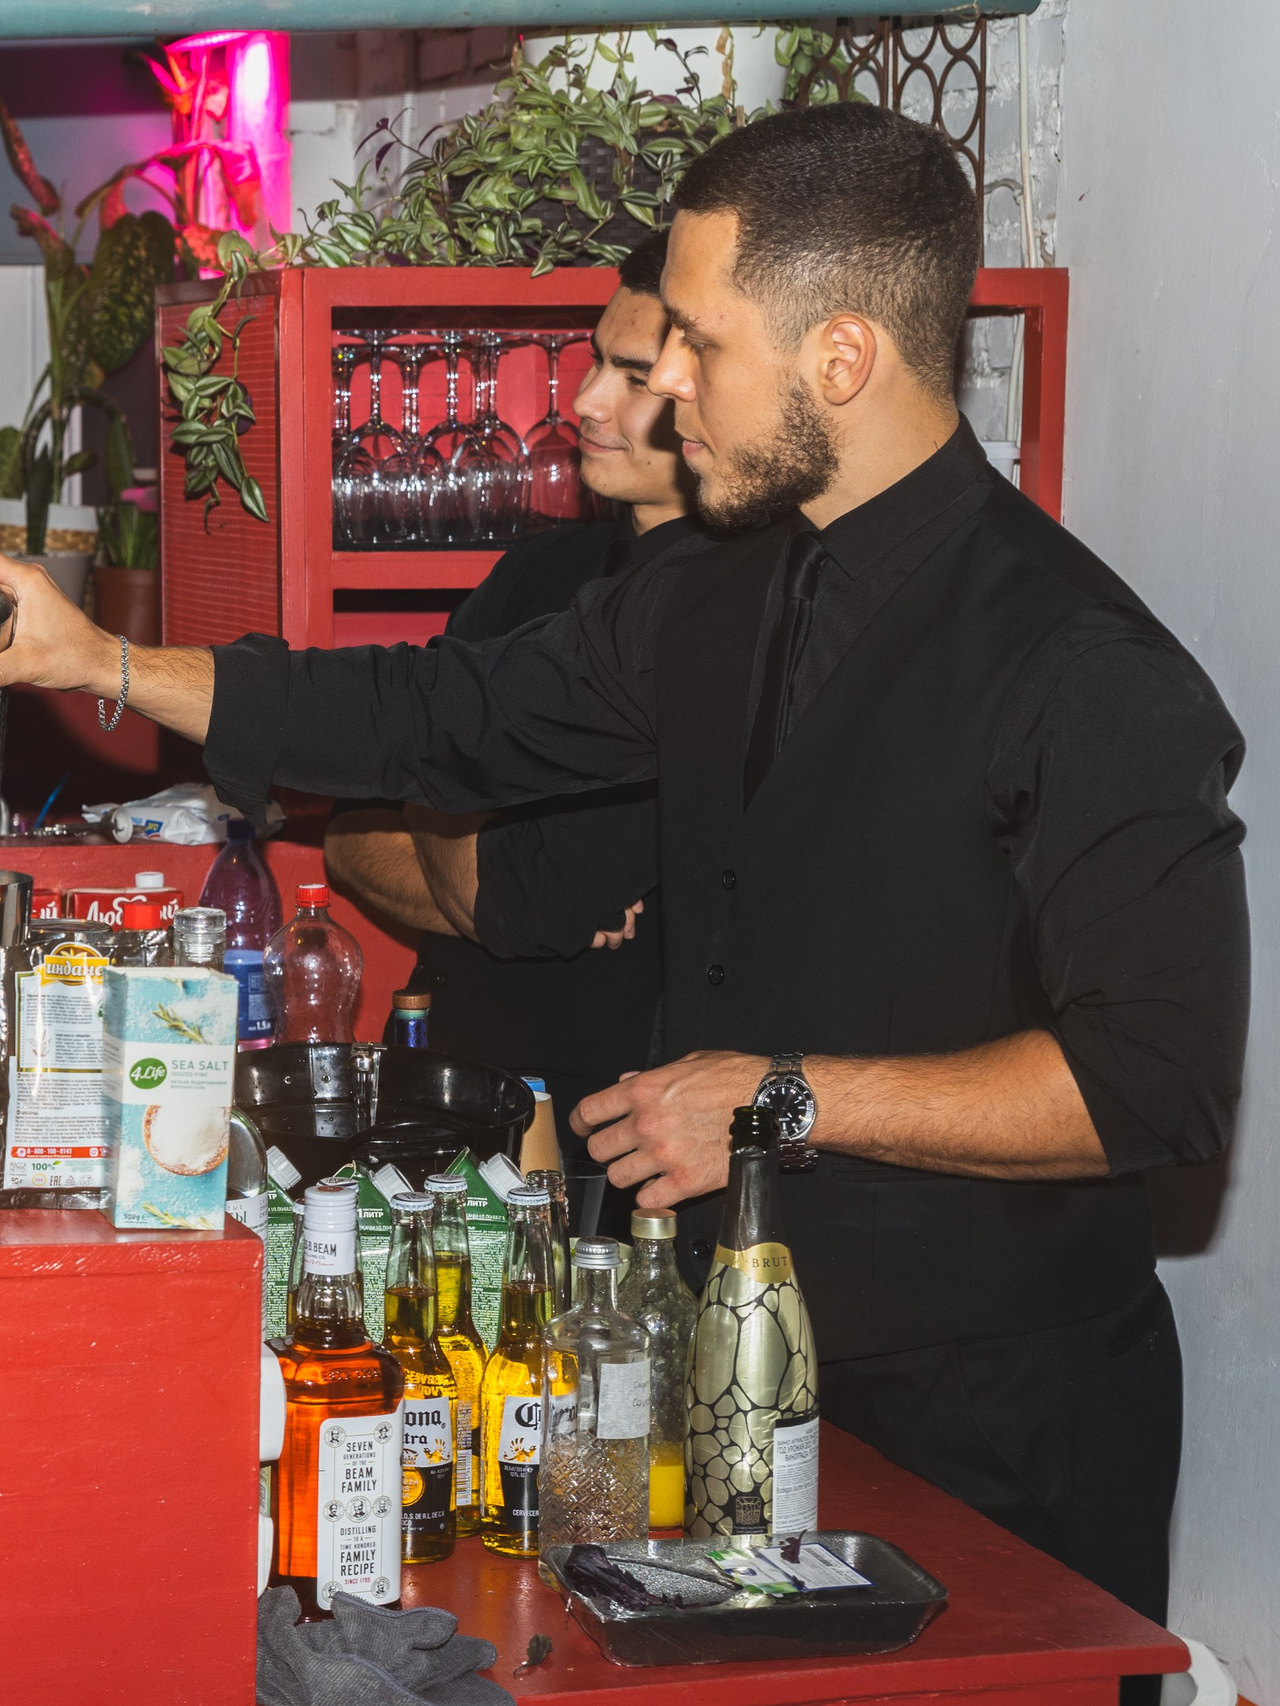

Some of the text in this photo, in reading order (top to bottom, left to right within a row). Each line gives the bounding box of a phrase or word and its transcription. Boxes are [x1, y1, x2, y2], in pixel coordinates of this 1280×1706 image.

[87, 895, 179, 925] Любый
[171, 1060, 229, 1071] SEA SALT
[130, 1065, 166, 1081] 4Life
[31, 1162, 56, 1171] 100%
[466, 1200, 488, 1208] ЛИТР
[363, 1211, 384, 1219] ЛИТР
[313, 1242, 337, 1257] BEAM
[752, 1256, 788, 1268] BRUT
[404, 1410, 442, 1427] ona
[403, 1433, 428, 1445] tra
[346, 1441, 373, 1452] SEVEN
[343, 1452, 376, 1460] GENERATIONS
[345, 1466, 373, 1480] BEAM
[341, 1479, 377, 1493] FAMILY
[512, 1509, 540, 1517] CERVECER
[339, 1525, 377, 1536] DISTILLING
[353, 1541, 376, 1549] HONORED
[340, 1549, 376, 1564] FAMILY
[340, 1562, 375, 1577] RECIPE
